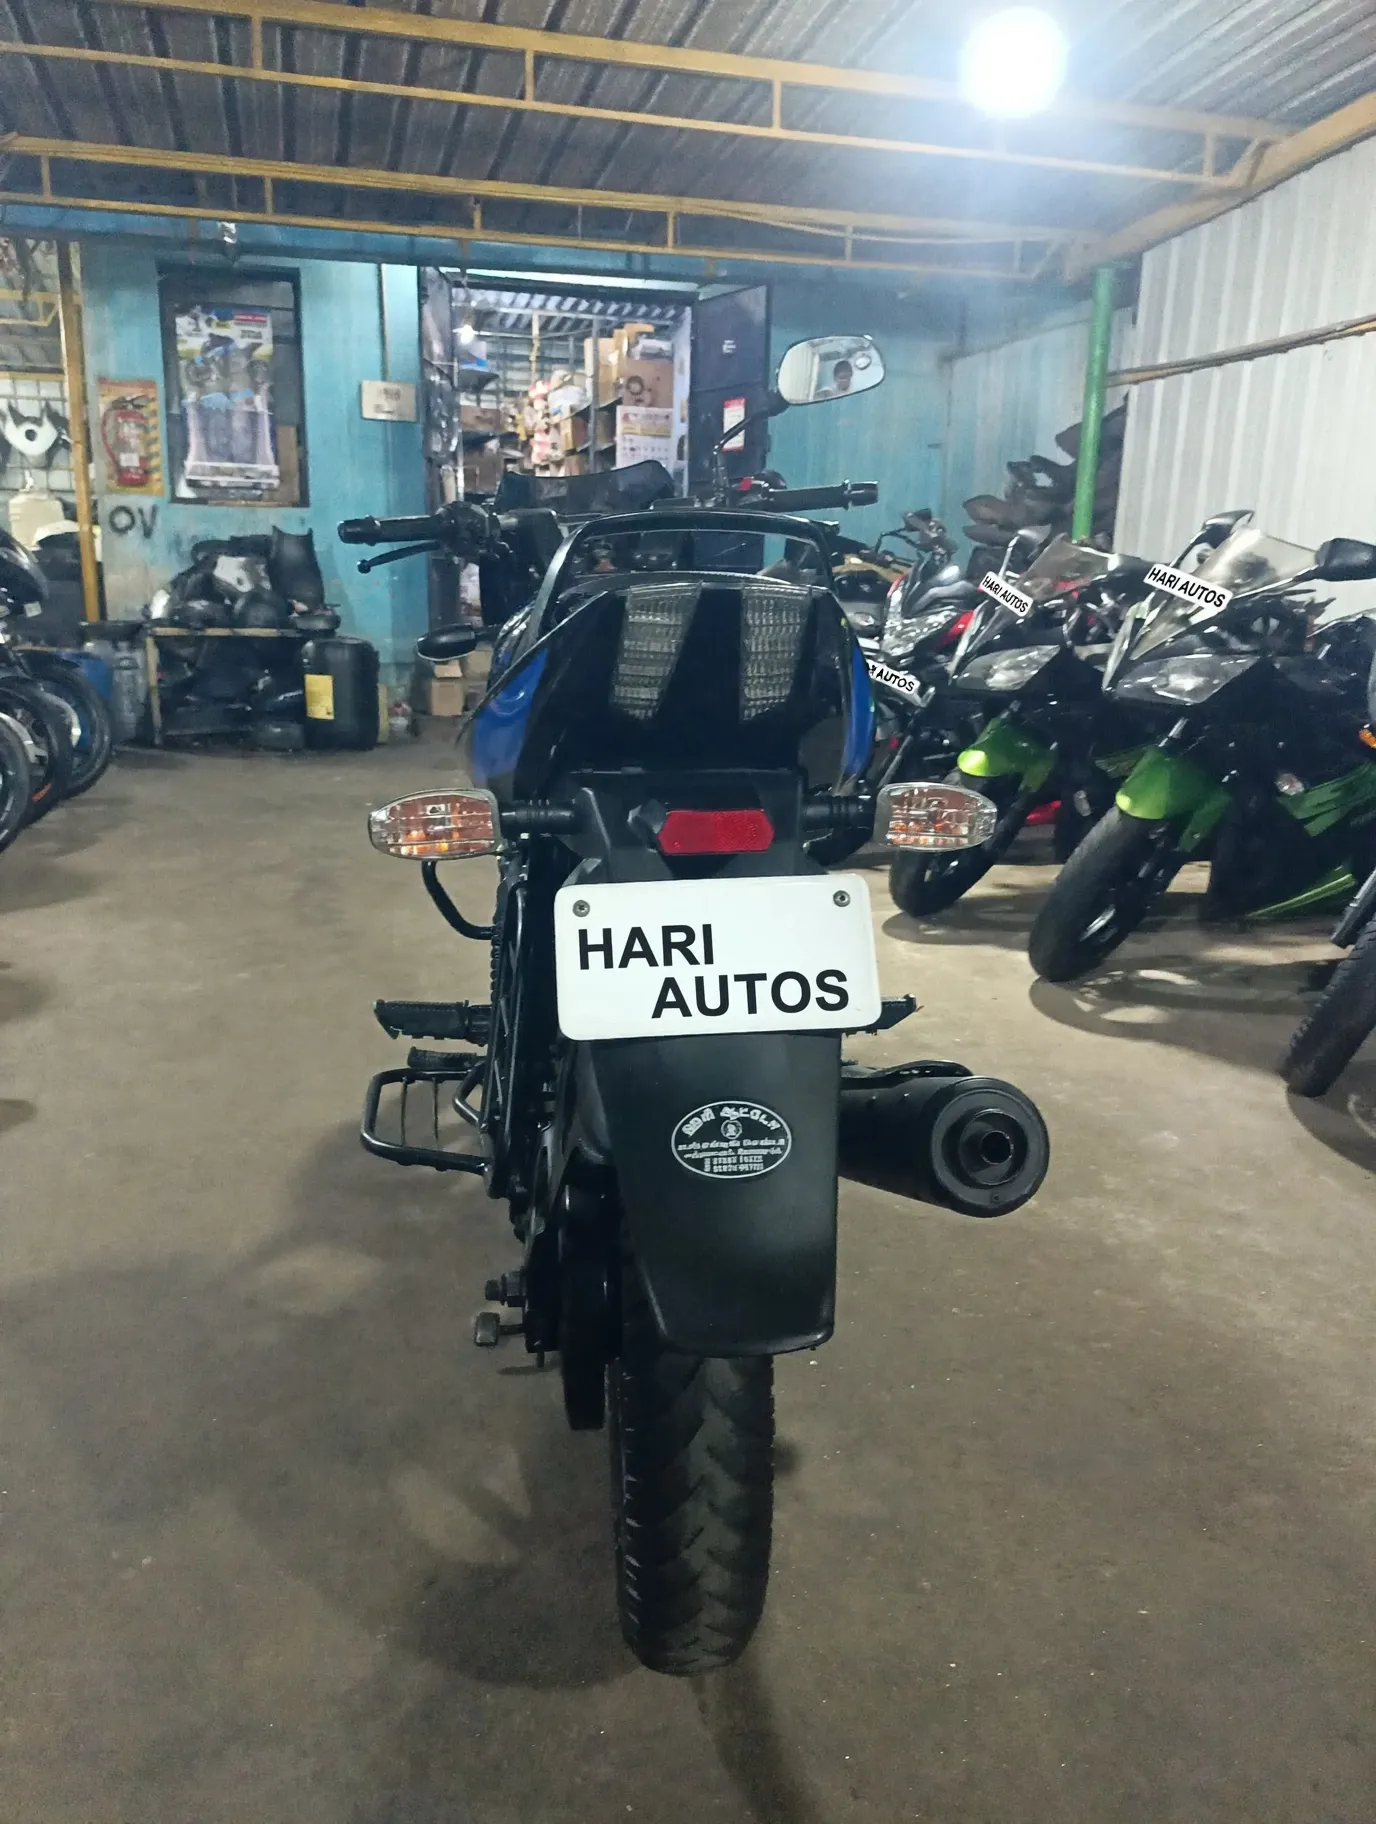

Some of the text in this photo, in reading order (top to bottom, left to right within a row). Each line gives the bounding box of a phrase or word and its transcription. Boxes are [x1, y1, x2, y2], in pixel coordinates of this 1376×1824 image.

[982, 575, 1028, 613] HARI AUTOS
[1147, 567, 1226, 607] HARI AUTOS
[875, 668, 914, 692] AUTOS
[578, 923, 715, 970] HARI
[651, 969, 849, 1019] AUTOS
